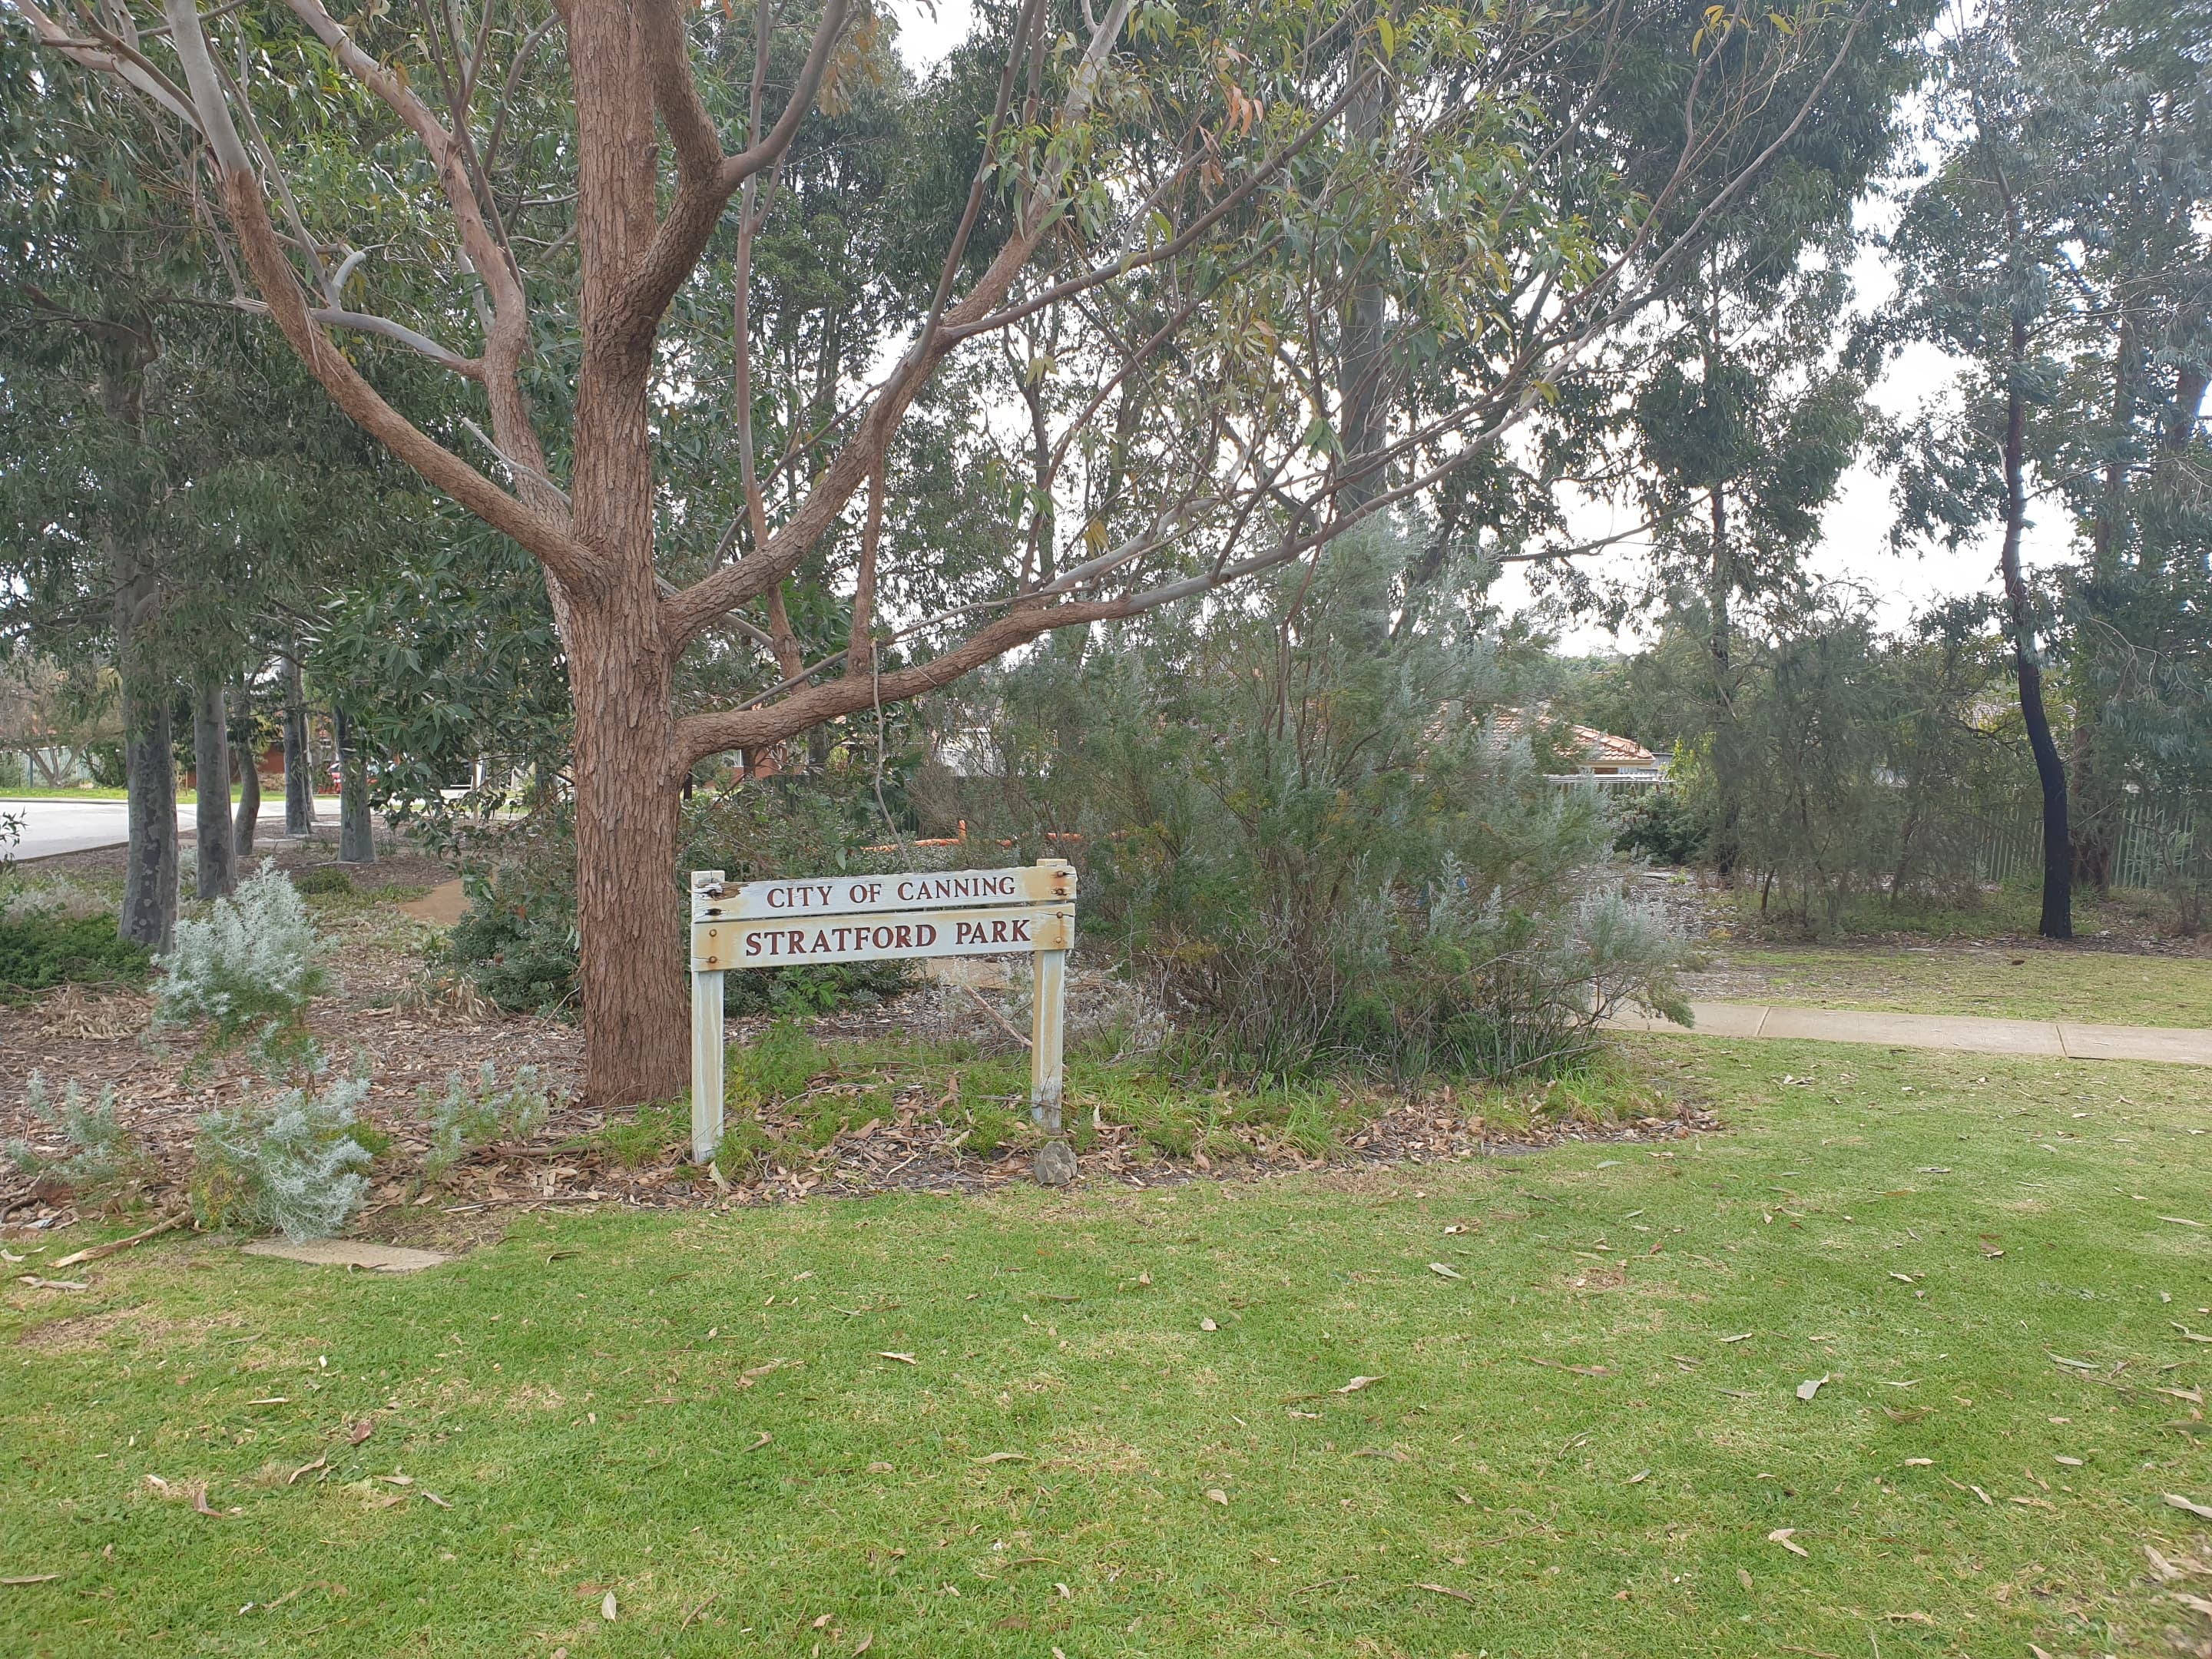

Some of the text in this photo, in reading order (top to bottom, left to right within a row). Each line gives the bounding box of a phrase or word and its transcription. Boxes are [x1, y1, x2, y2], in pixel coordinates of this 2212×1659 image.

[767, 876, 1016, 908] CITY OF CANNING
[746, 919, 1031, 957] STRATFORD PARK
